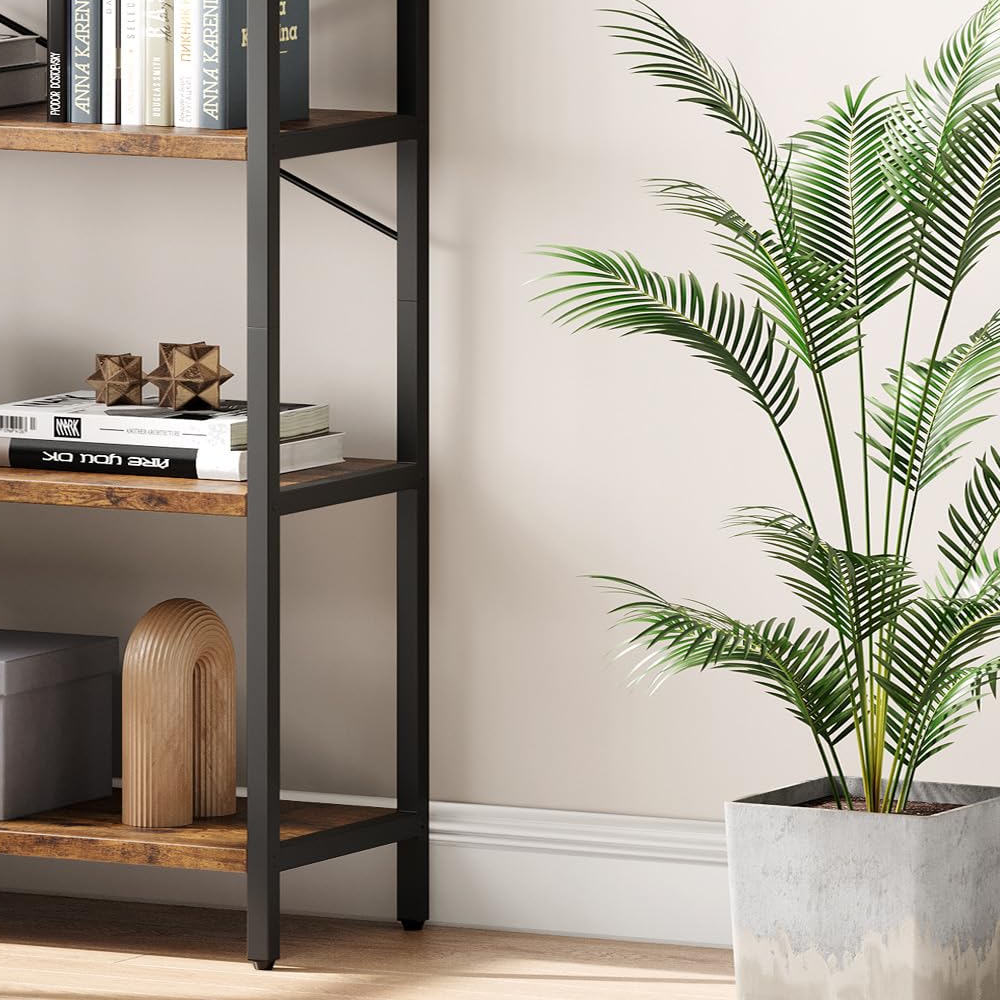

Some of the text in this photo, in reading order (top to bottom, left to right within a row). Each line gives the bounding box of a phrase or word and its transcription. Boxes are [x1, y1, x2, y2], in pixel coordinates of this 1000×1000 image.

[180, 7, 192, 63] ПИКНИК
[50, 52, 62, 116] FYODOR DOSTOEVSKY
[74, 62, 91, 115] ANNA
[151, 56, 161, 118] DOUGLAS SMITH
[202, 67, 219, 121] ANNA
[55, 417, 81, 437] MARK
[41, 450, 74, 464] OK
[127, 456, 170, 470] ARE
